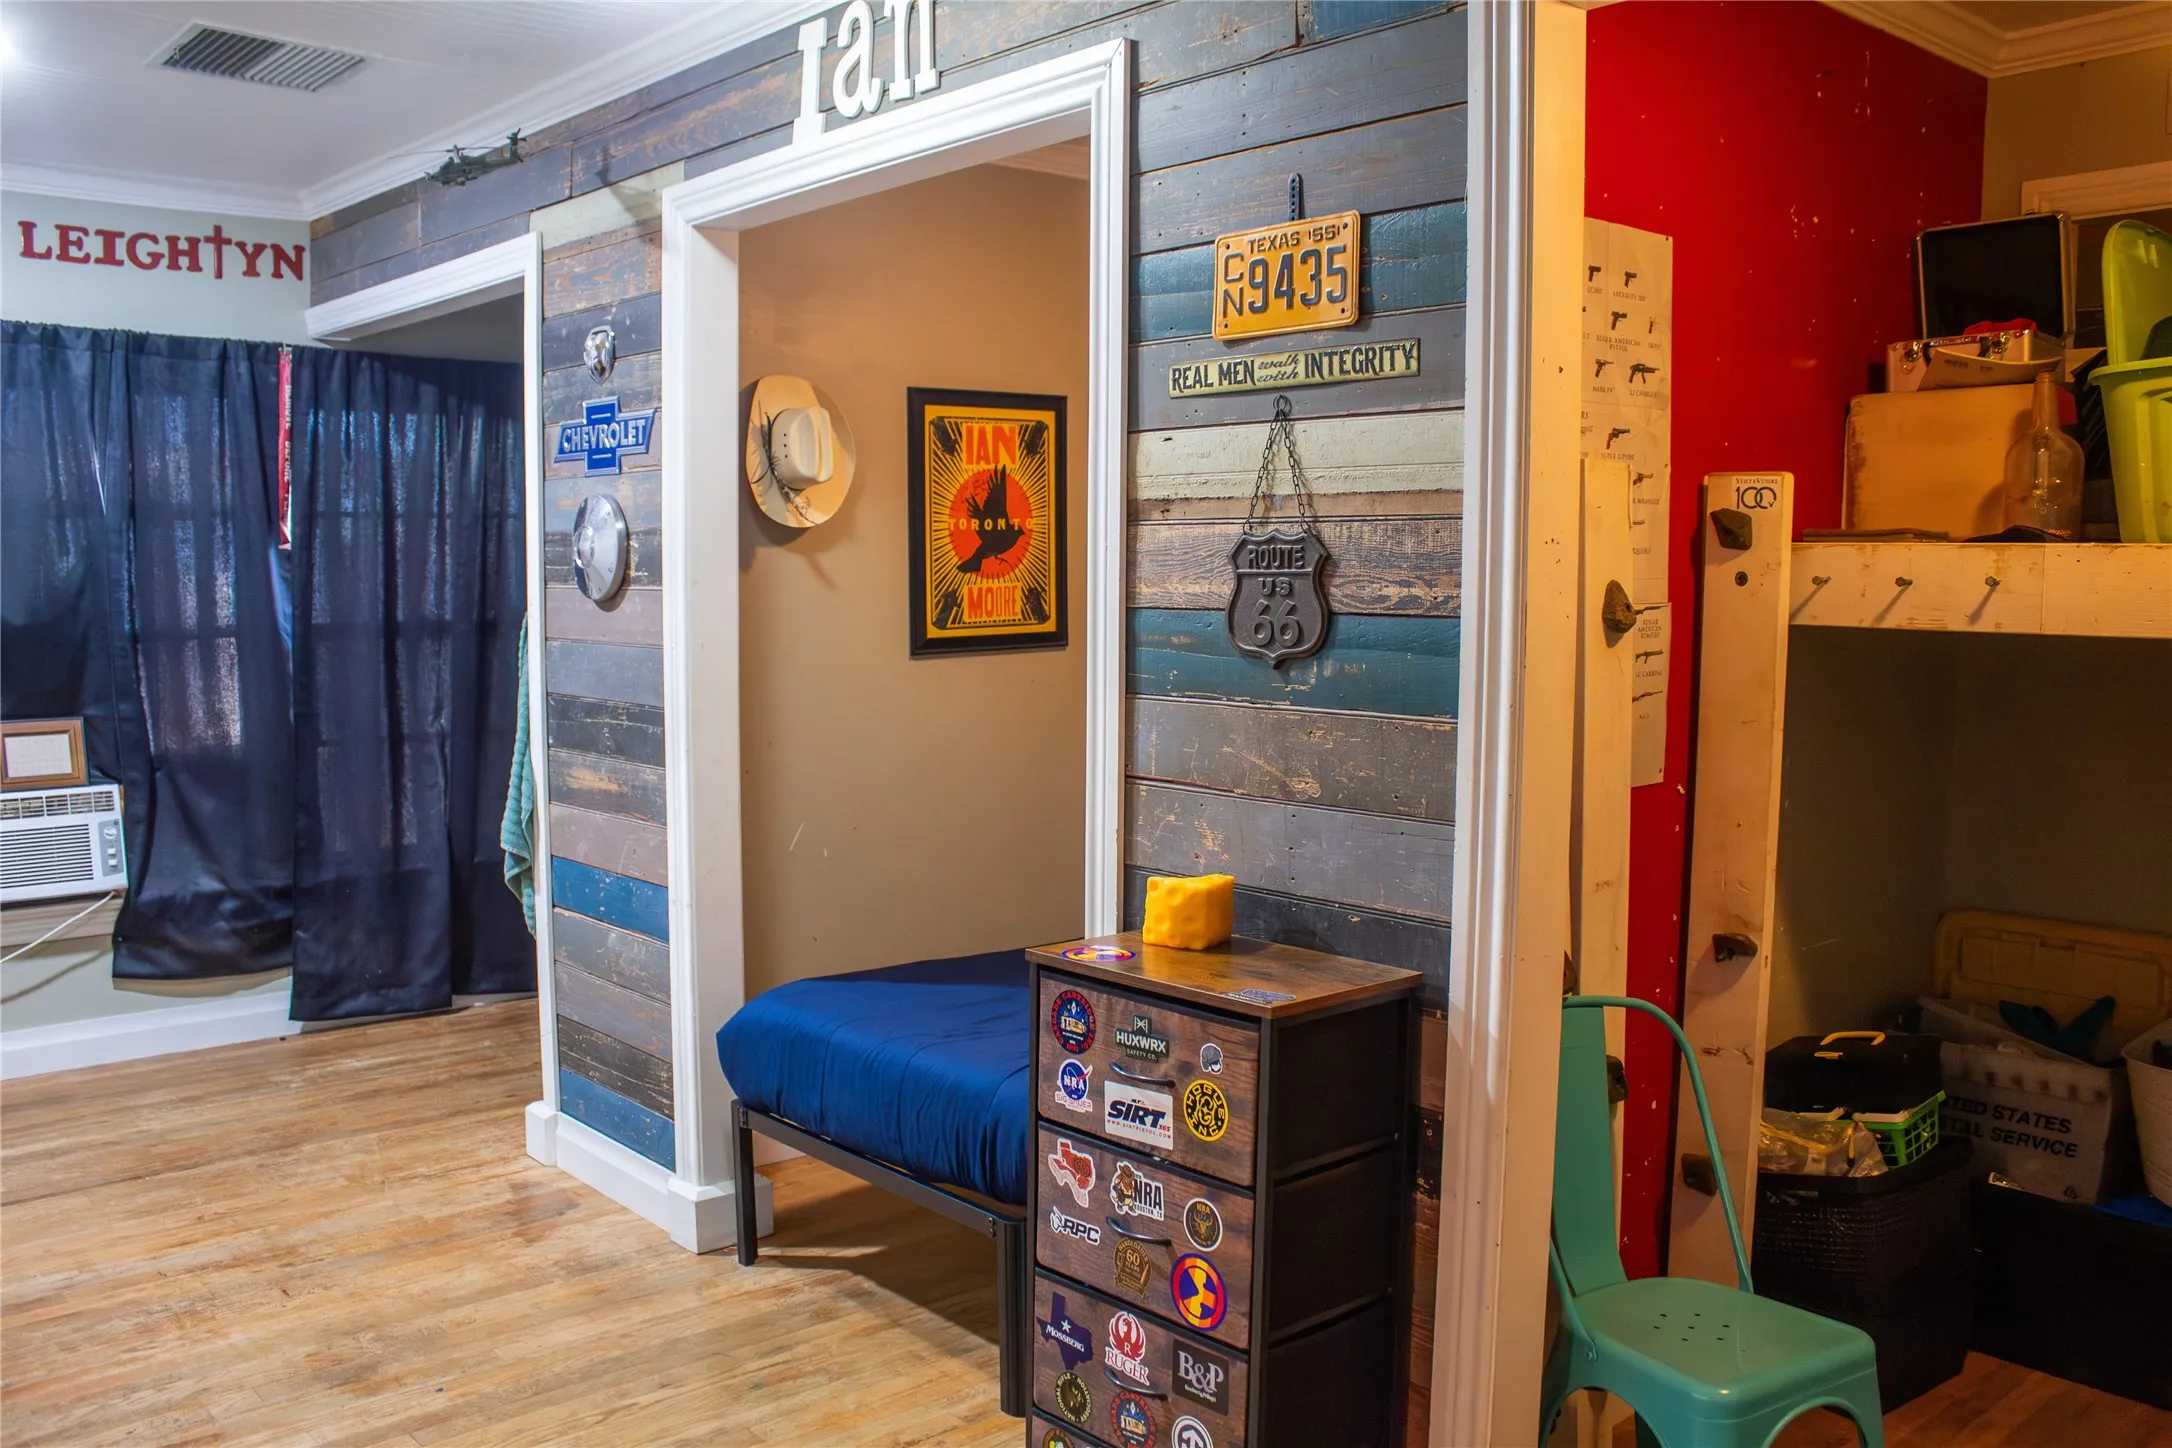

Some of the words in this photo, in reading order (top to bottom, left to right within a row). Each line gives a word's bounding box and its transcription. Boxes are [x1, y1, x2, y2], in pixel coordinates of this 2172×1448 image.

[791, 0, 942, 145] Ian
[1247, 231, 1301, 254] TEXAS
[1248, 245, 1347, 314] 9435
[1218, 358, 1256, 387] MEN
[1257, 353, 1300, 370] walk
[1304, 341, 1416, 380] INTEGRITY
[1171, 366, 1214, 393] REAL
[1257, 370, 1300, 383] with
[562, 419, 646, 453] CHEVROLET
[964, 424, 1017, 466] IAN
[948, 517, 1034, 532] TORONTO
[1246, 545, 1306, 570] ROUTE
[1257, 576, 1292, 597] US
[967, 584, 1019, 620] MOORE
[1250, 599, 1301, 648] 66
[1116, 1031, 1166, 1053] HUXWRX
[1126, 1048, 1147, 1058] SAFETY
[1063, 1074, 1086, 1091] NRA
[1107, 1099, 1167, 1130] SIRT
[1186, 1084, 1225, 1120] HOGUE
[1991, 1104, 2073, 1134] STATES
[1989, 1126, 2079, 1158] SERVICE
[1133, 1178, 1163, 1212] NRA
[1063, 1218, 1100, 1244] RPC
[1126, 1249, 1140, 1267] 60
[1046, 1324, 1085, 1353] MOSSBERG
[1106, 1349, 1149, 1386] RUGER
[1177, 1349, 1225, 1394] B&P
